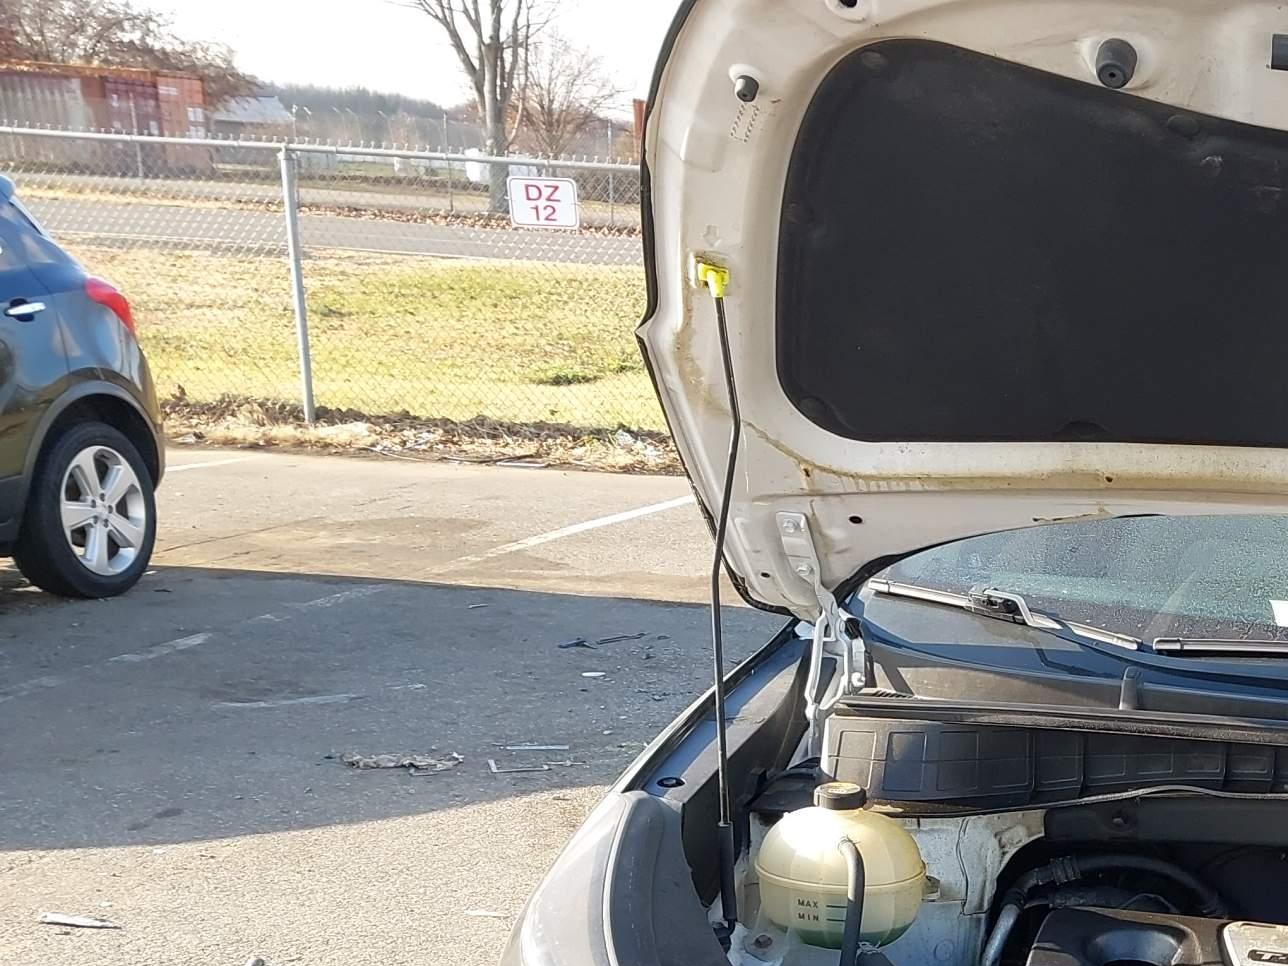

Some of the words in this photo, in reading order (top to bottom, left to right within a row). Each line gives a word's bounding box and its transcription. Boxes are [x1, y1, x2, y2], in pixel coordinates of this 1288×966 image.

[524, 184, 561, 202] DZ
[530, 204, 557, 221] 12
[797, 898, 819, 909] MAX
[797, 912, 819, 921] MIN
